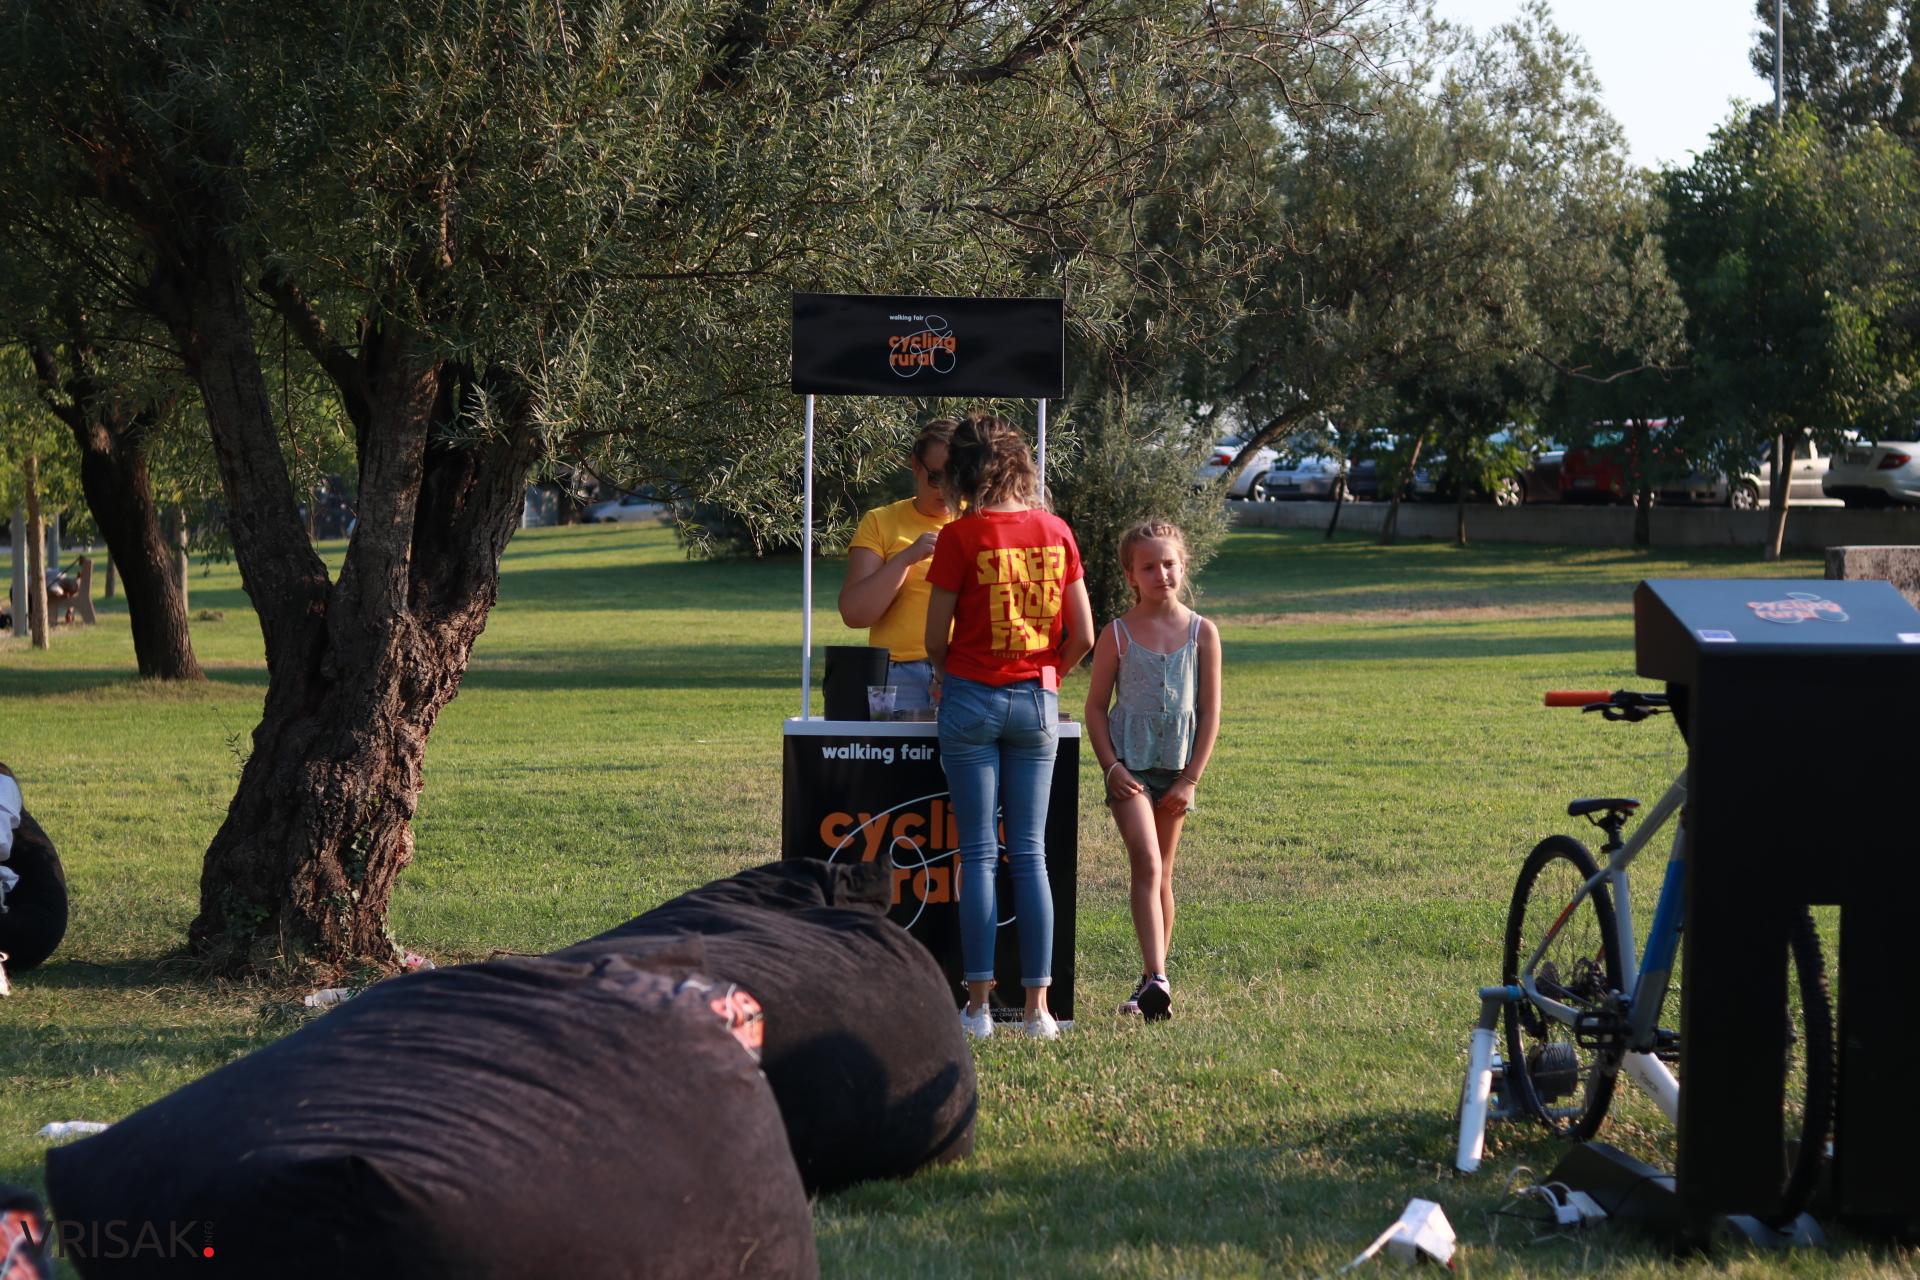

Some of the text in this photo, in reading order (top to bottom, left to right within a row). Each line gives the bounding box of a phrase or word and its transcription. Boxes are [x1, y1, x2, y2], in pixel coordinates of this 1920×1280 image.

[889, 314, 912, 322] walking
[888, 332, 956, 353] cycling
[890, 349, 935, 367] rural
[976, 546, 1066, 585] STREET
[990, 580, 1061, 622] FOOD
[991, 617, 1054, 651] FEST
[822, 743, 934, 765] walking fair
[819, 799, 1009, 863] cycli
